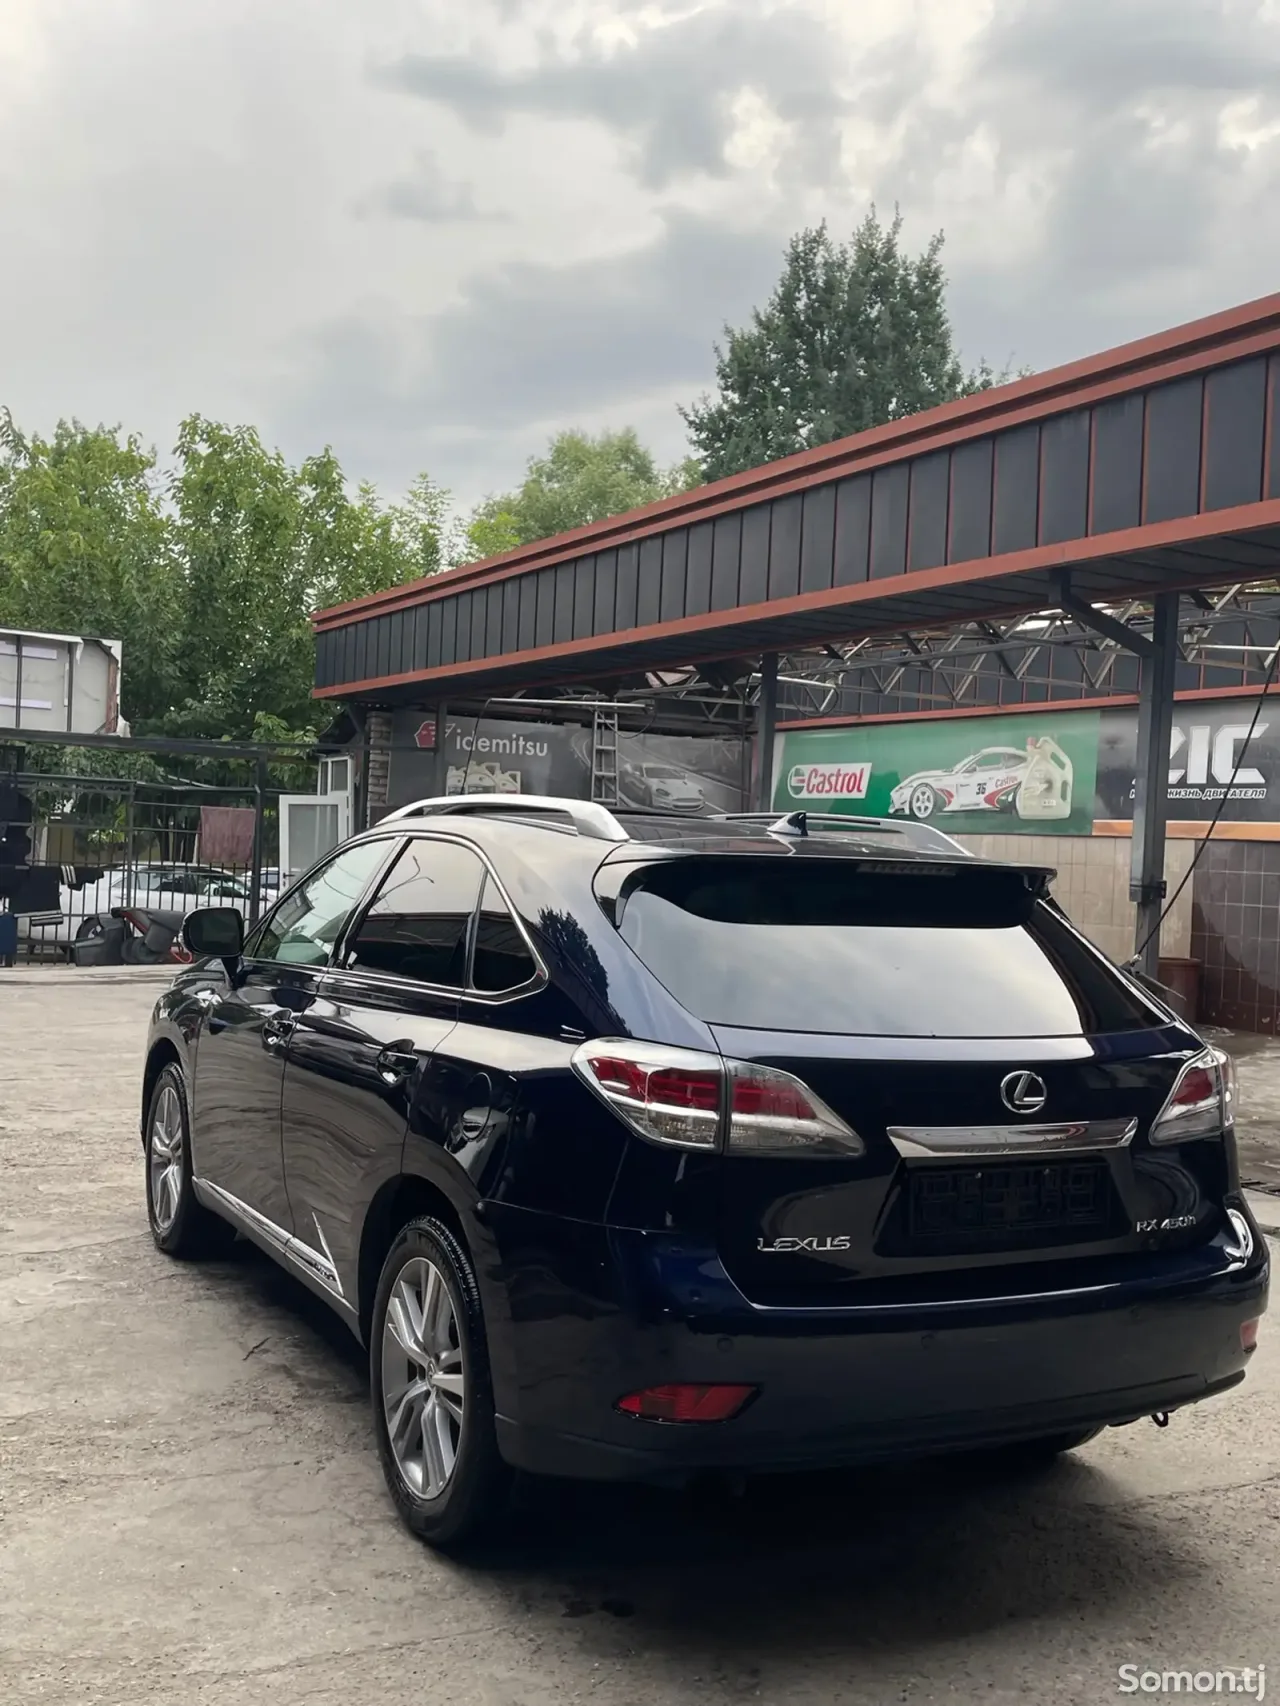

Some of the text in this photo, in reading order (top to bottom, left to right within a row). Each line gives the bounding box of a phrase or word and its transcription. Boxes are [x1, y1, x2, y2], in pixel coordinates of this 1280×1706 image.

[455, 729, 549, 758] idemitsu
[806, 767, 864, 794] Castrol
[1136, 1214, 1197, 1233] RX 450h
[757, 1236, 851, 1252] LEXUS
